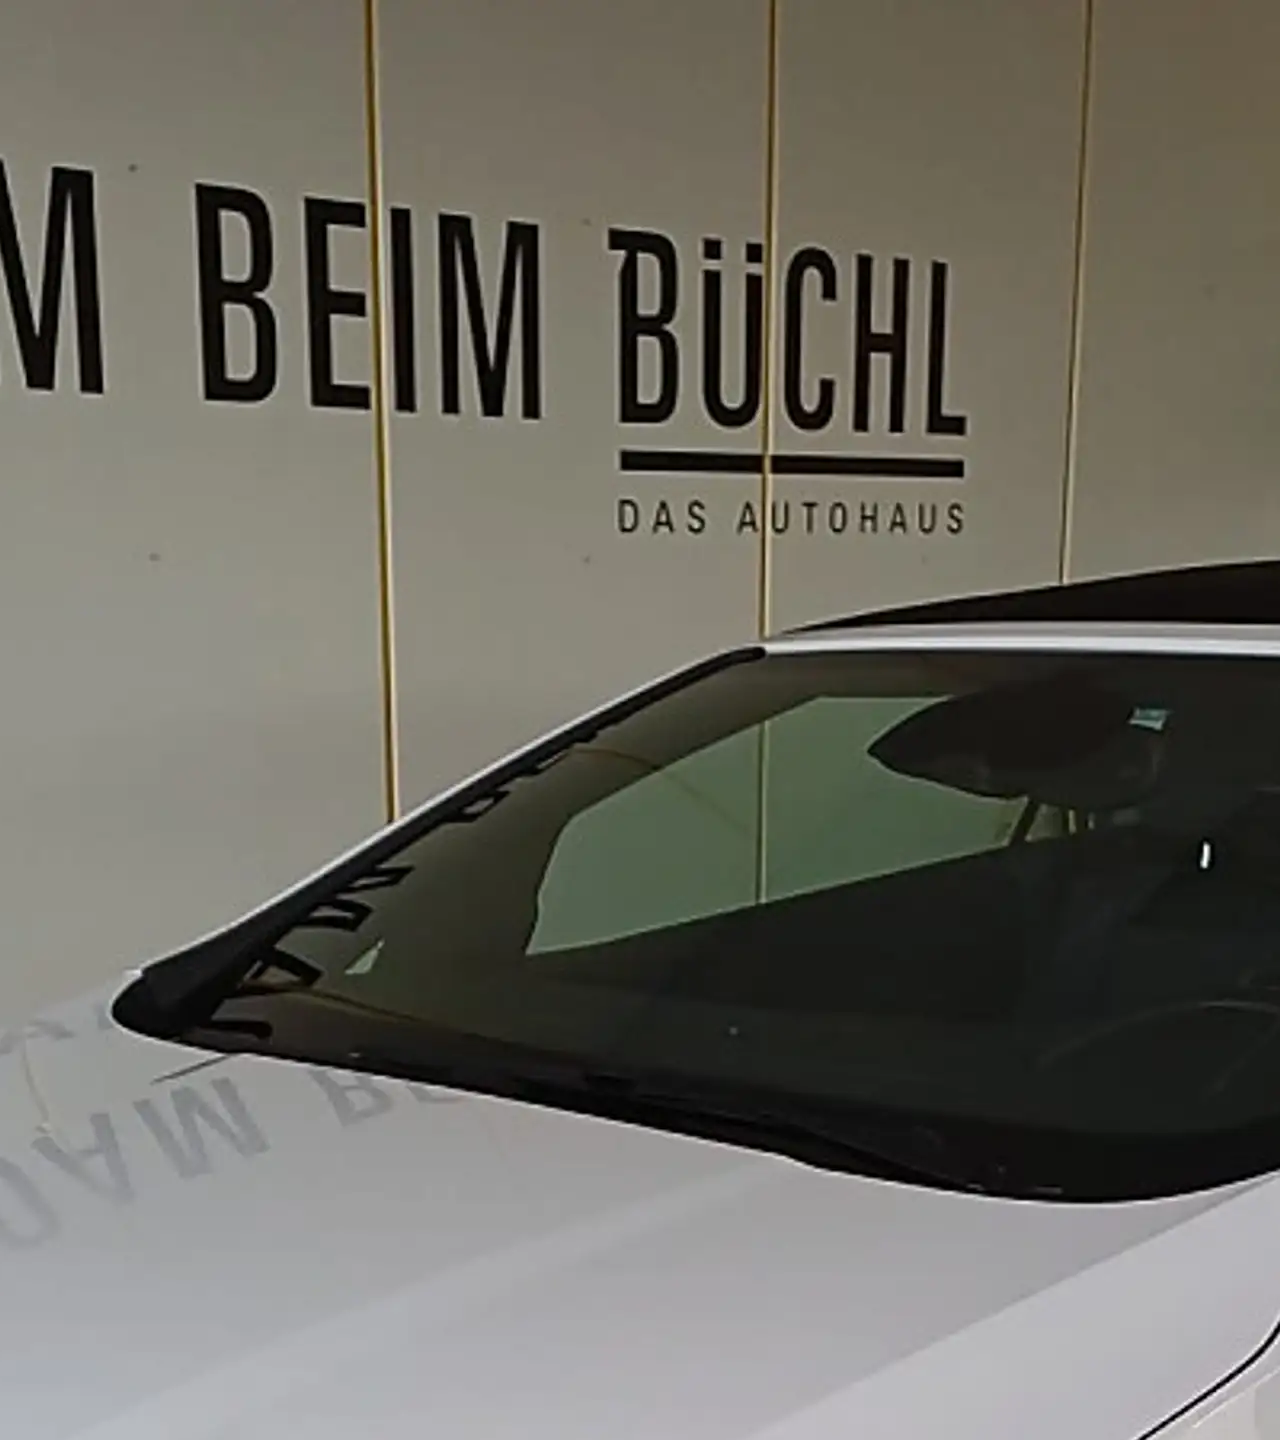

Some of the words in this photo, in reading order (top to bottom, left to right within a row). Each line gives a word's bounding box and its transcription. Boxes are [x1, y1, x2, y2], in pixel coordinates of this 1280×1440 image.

[193, 182, 543, 421] BEIM
[607, 226, 968, 437] BÜCHL
[617, 498, 707, 535] DAS
[736, 499, 966, 536] AUTOHAUS
